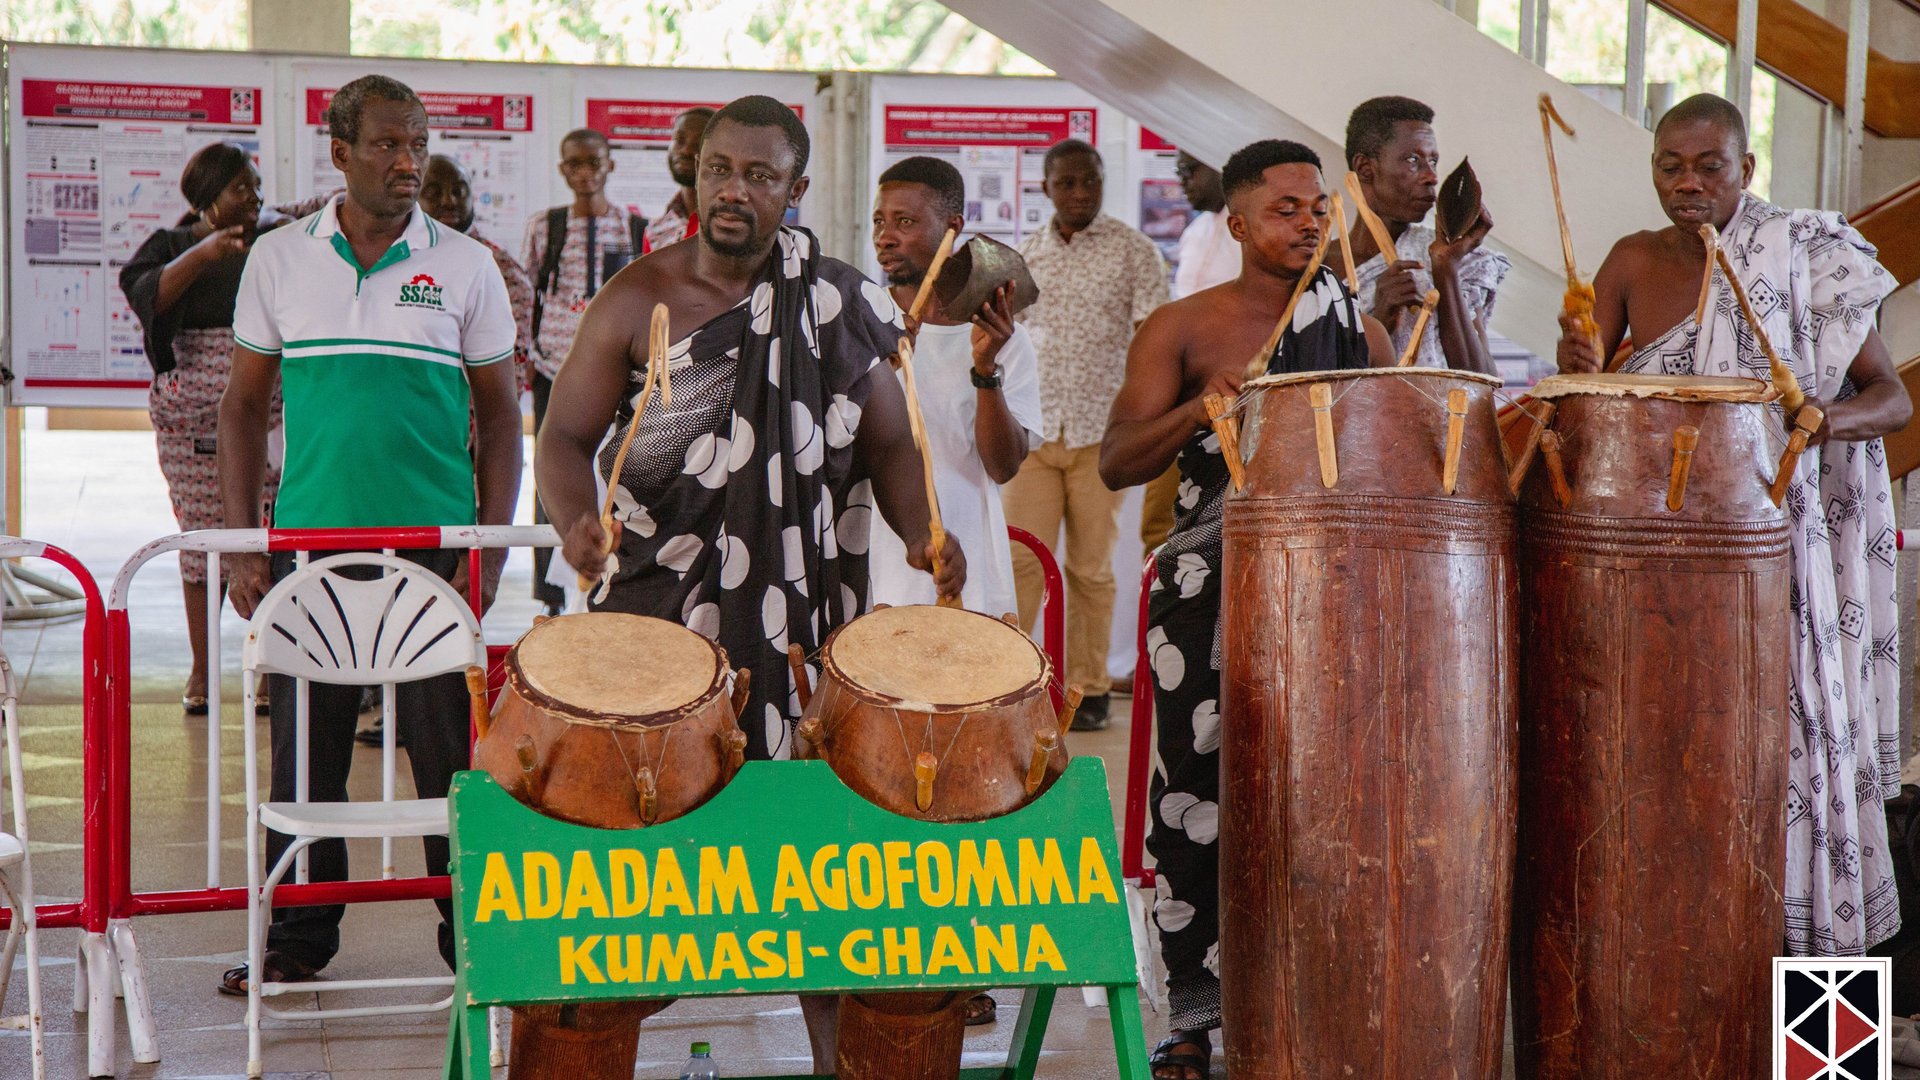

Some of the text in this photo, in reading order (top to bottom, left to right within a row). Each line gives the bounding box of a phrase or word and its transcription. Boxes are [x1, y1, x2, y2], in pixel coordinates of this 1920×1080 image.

[56, 84, 91, 95] GLOBAL
[130, 87, 149, 97] AND
[400, 285, 443, 306] SSAK
[474, 837, 1119, 922] ADADAM AGOFOMMA
